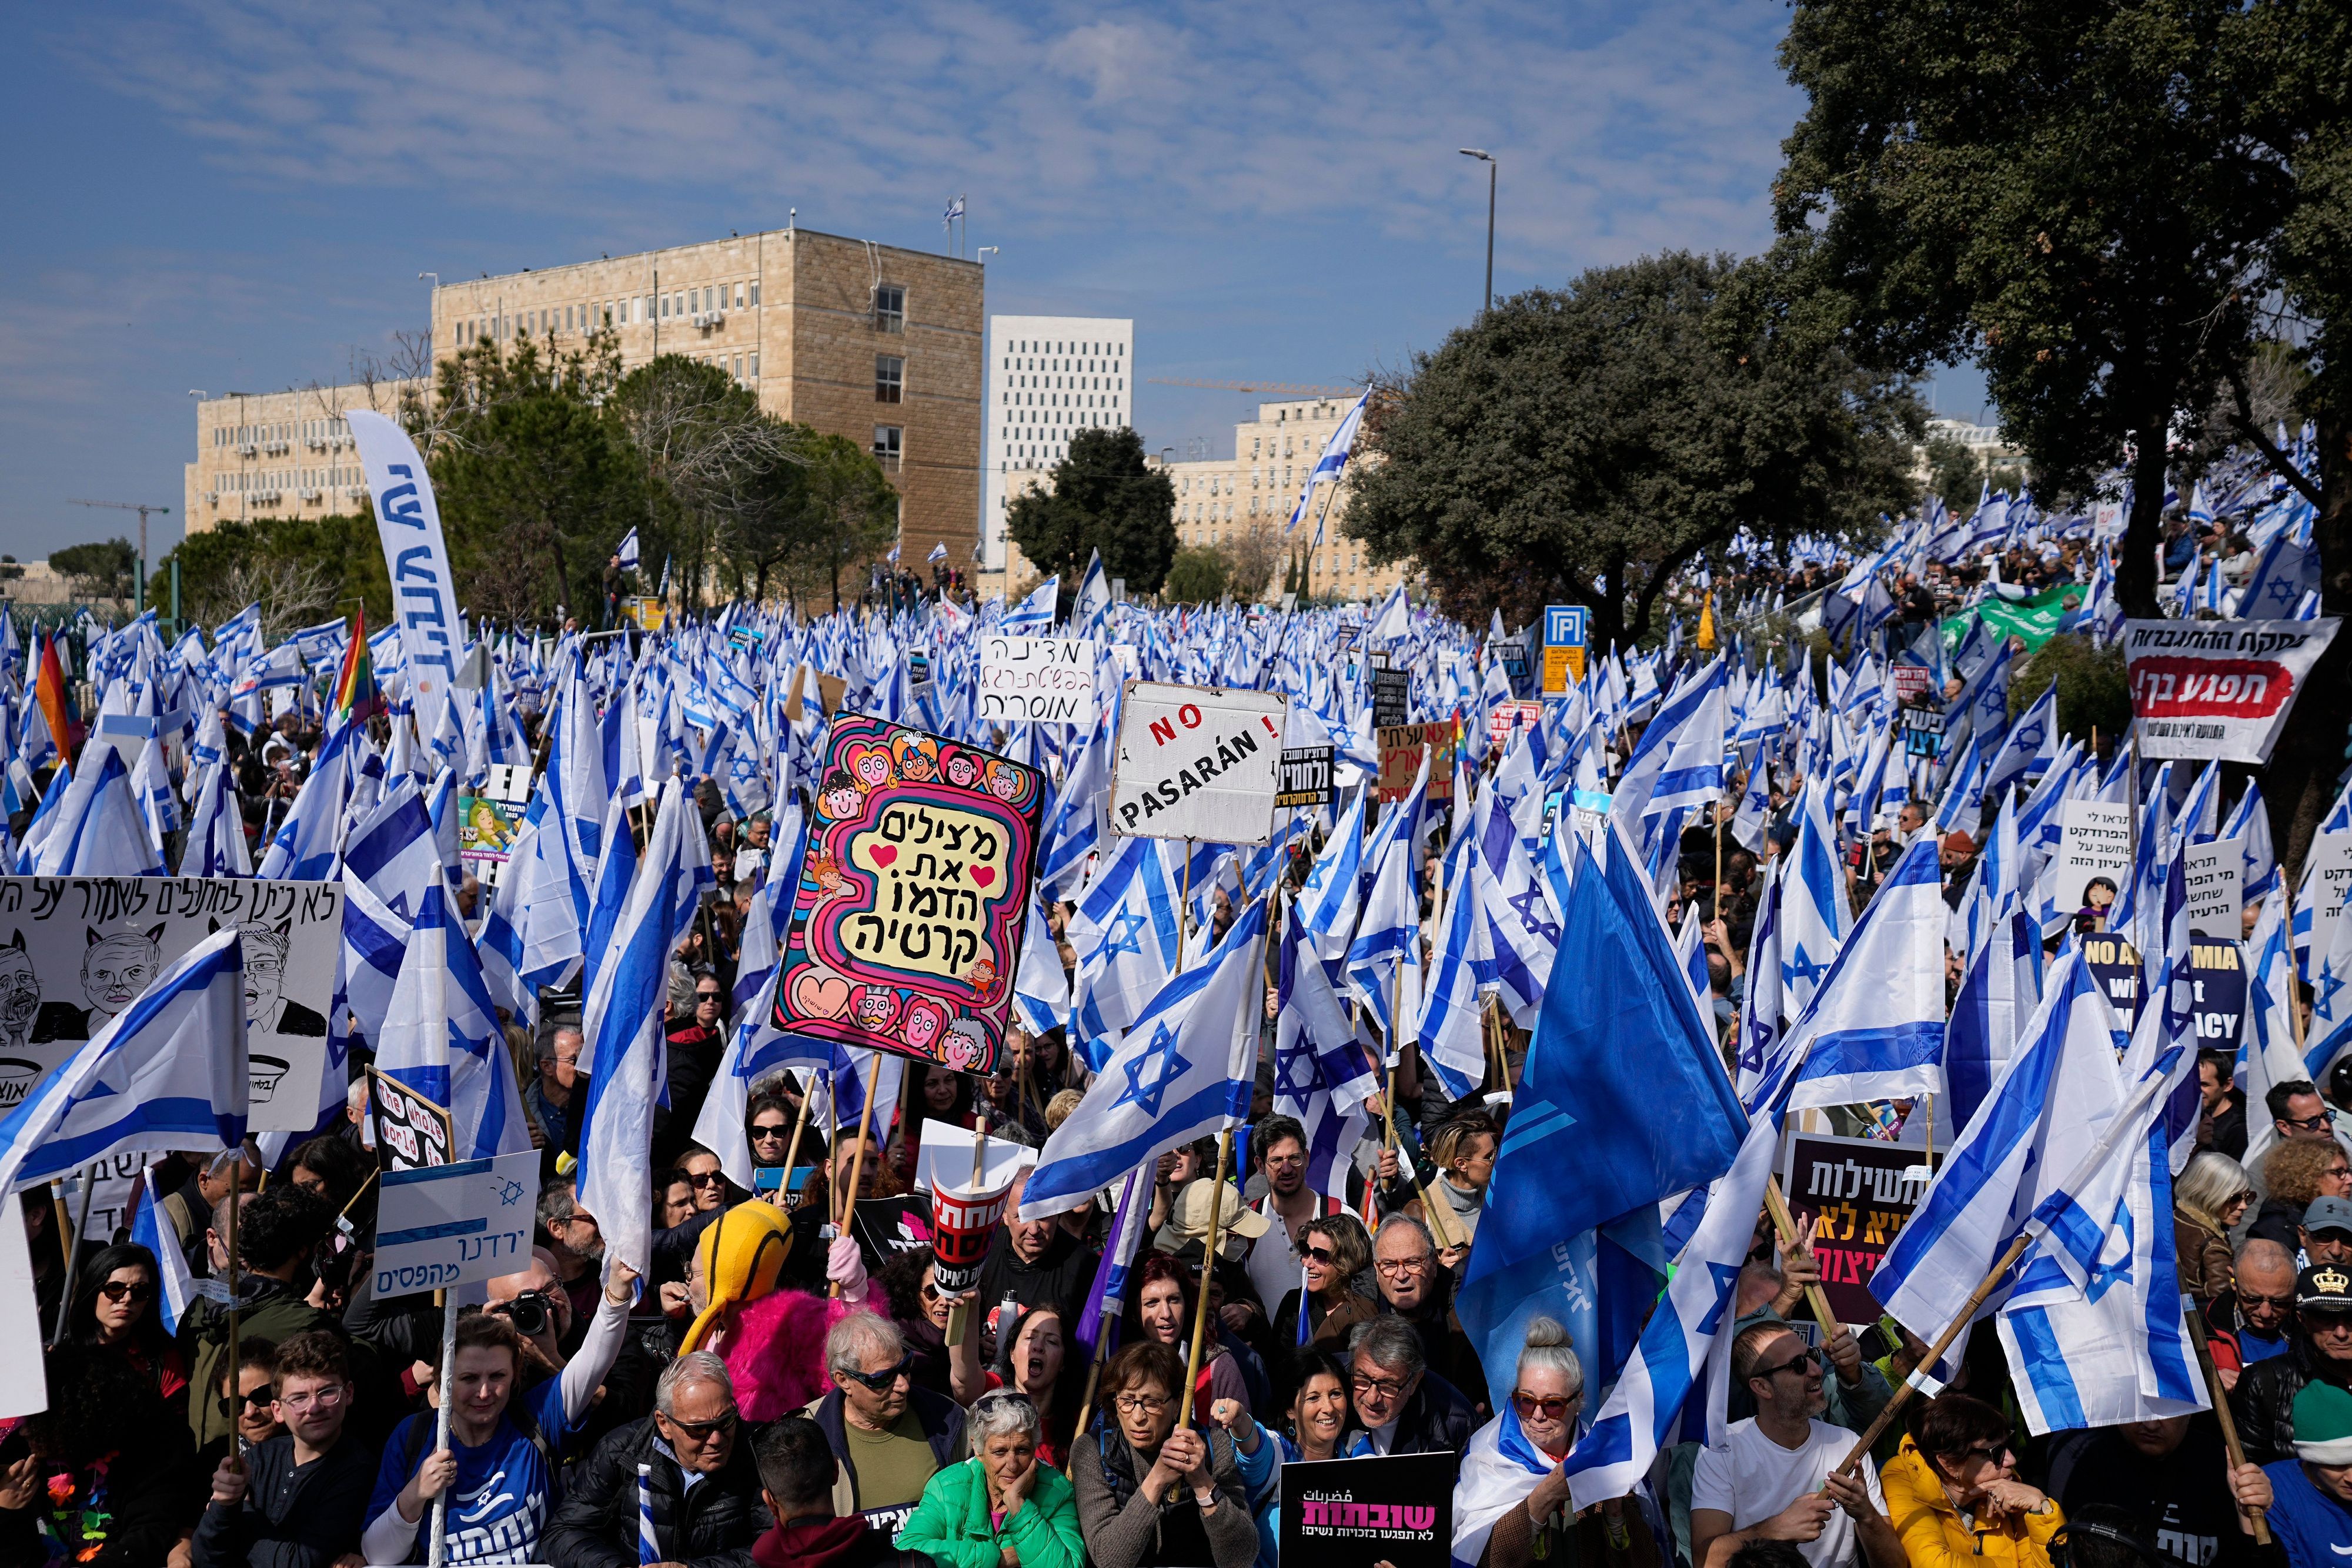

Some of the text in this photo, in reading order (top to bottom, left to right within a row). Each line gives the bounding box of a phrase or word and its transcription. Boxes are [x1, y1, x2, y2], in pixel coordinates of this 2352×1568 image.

[380, 464, 426, 530] יש
[991, 640, 1081, 664] מדינה
[522, 692, 540, 703] SAVE
[2179, 674, 2267, 703] תפגע
[981, 694, 1078, 720] מוסרית
[1903, 708, 1946, 733] פשי
[1149, 703, 1202, 746] NO
[1425, 723, 1445, 743] לא
[1282, 749, 1302, 761] ועובד
[1385, 748, 1424, 777] ארץ
[1119, 730, 1258, 828] PASARÁN
[1318, 791, 1328, 802] על
[881, 808, 997, 861] מצילים
[2069, 826, 2128, 840] הפרודקט
[2077, 840, 2094, 851] על
[906, 854, 963, 883] את
[2219, 870, 2234, 881] מי
[31, 877, 65, 920] על
[301, 882, 335, 924] לא
[2187, 888, 2223, 903] שחש
[2190, 904, 2230, 919] הרעיו
[855, 915, 978, 974] קרטיה
[2085, 941, 2115, 965] NO
[379, 1085, 443, 1140] The whole
[382, 1124, 417, 1156] world
[1816, 1202, 1857, 1241] לא
[458, 1230, 524, 1261] ירדנו
[377, 1263, 460, 1293] מהפסים
[1551, 1241, 1592, 1313] שראל
[1302, 1501, 1435, 1530] שובתות
[1302, 1526, 1434, 1540] לא תפגעו בזכויות נשים!
